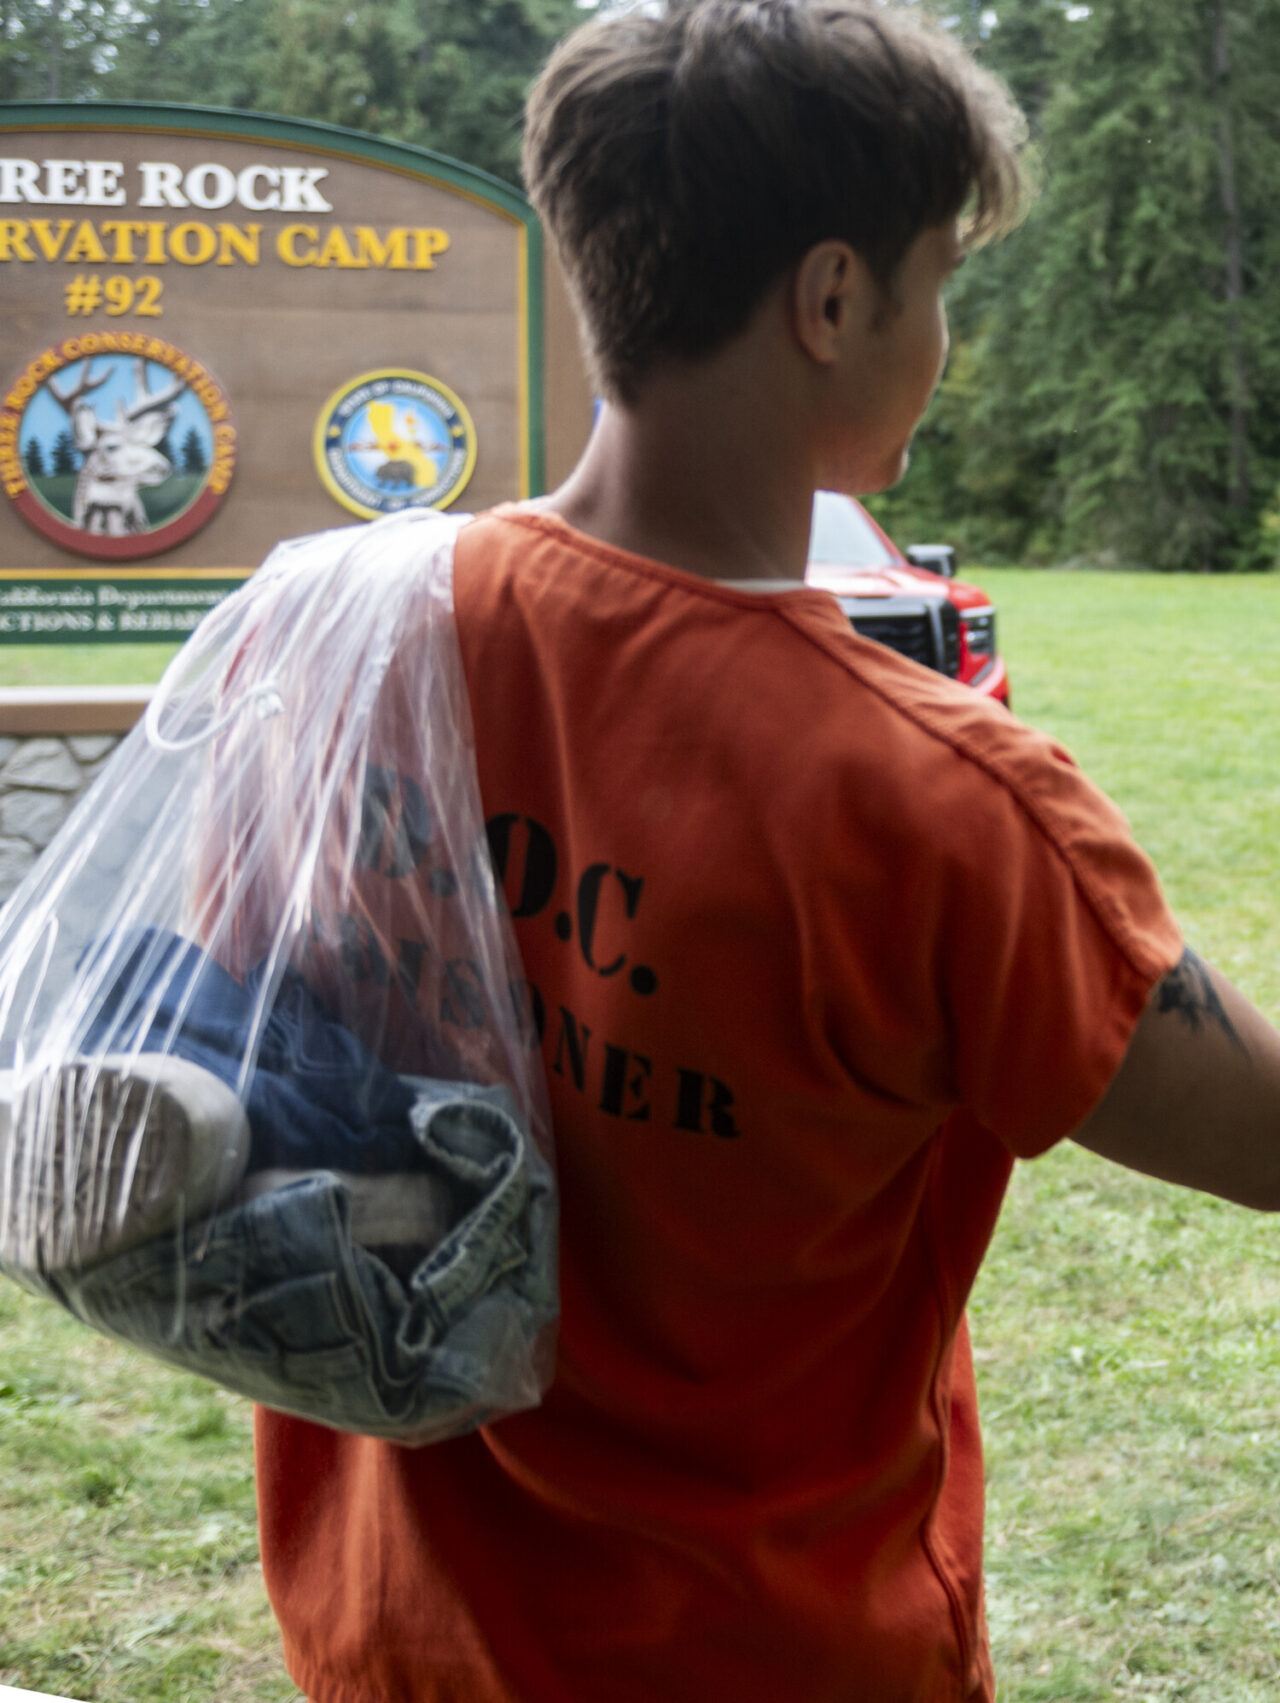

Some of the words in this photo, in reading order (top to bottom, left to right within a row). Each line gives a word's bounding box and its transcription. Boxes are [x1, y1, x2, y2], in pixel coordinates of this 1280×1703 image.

[0, 158, 126, 206] REE
[137, 162, 333, 212] ROCK
[0, 218, 262, 266] RVATION
[277, 223, 450, 270] CAMP
[64, 274, 164, 317] #92
[5, 349, 63, 410] ROCK
[62, 331, 229, 421] CONSERVATION
[207, 424, 237, 495] CAMP
[0, 610, 95, 632] CTIONS
[97, 611, 115, 631] &
[303, 905, 742, 1139] RISONER
